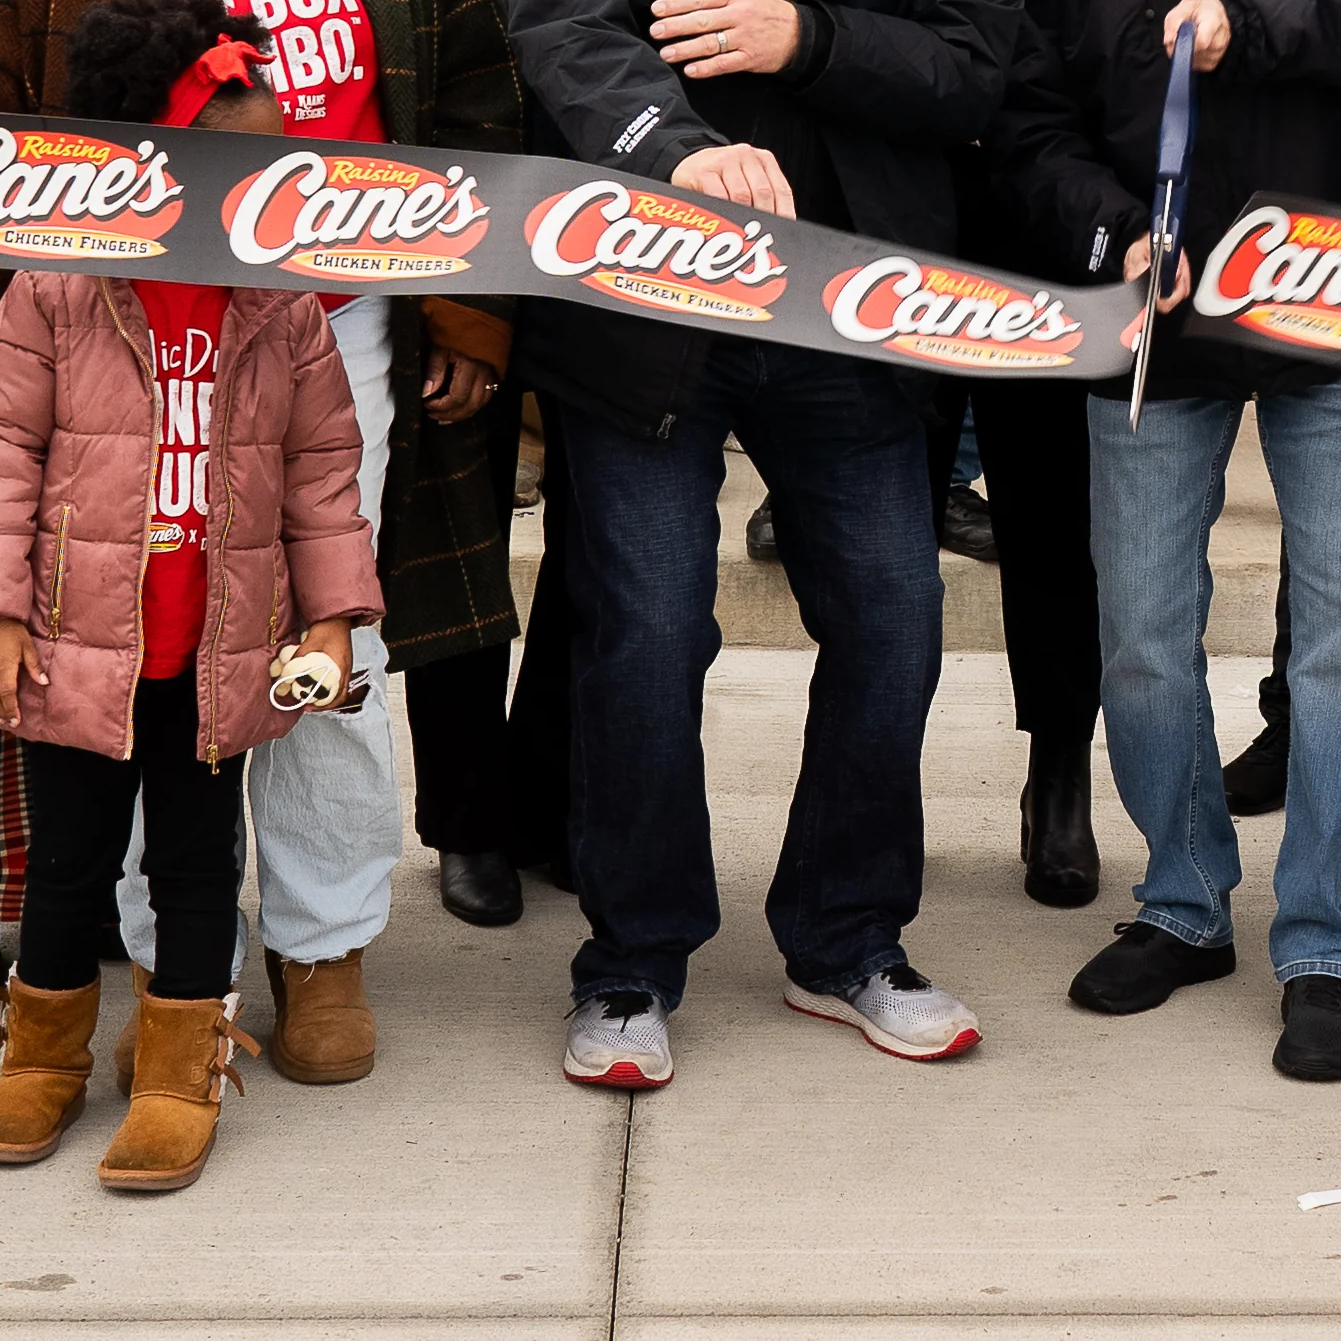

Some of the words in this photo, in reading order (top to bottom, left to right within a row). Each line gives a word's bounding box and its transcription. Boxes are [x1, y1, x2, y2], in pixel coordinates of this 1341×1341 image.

[19, 136, 111, 165] Raising
[329, 161, 419, 190] Raising
[229, 151, 491, 264] Cane's
[633, 195, 719, 235] Raising
[4, 230, 73, 248] CHICKEN
[81, 236, 148, 254] FINGERS
[531, 180, 788, 285] Cane's
[313, 253, 380, 270] CHICKEN
[387, 258, 452, 271] FINGERS
[614, 276, 681, 303] CHICKEN
[831, 256, 1082, 342] Cane's
